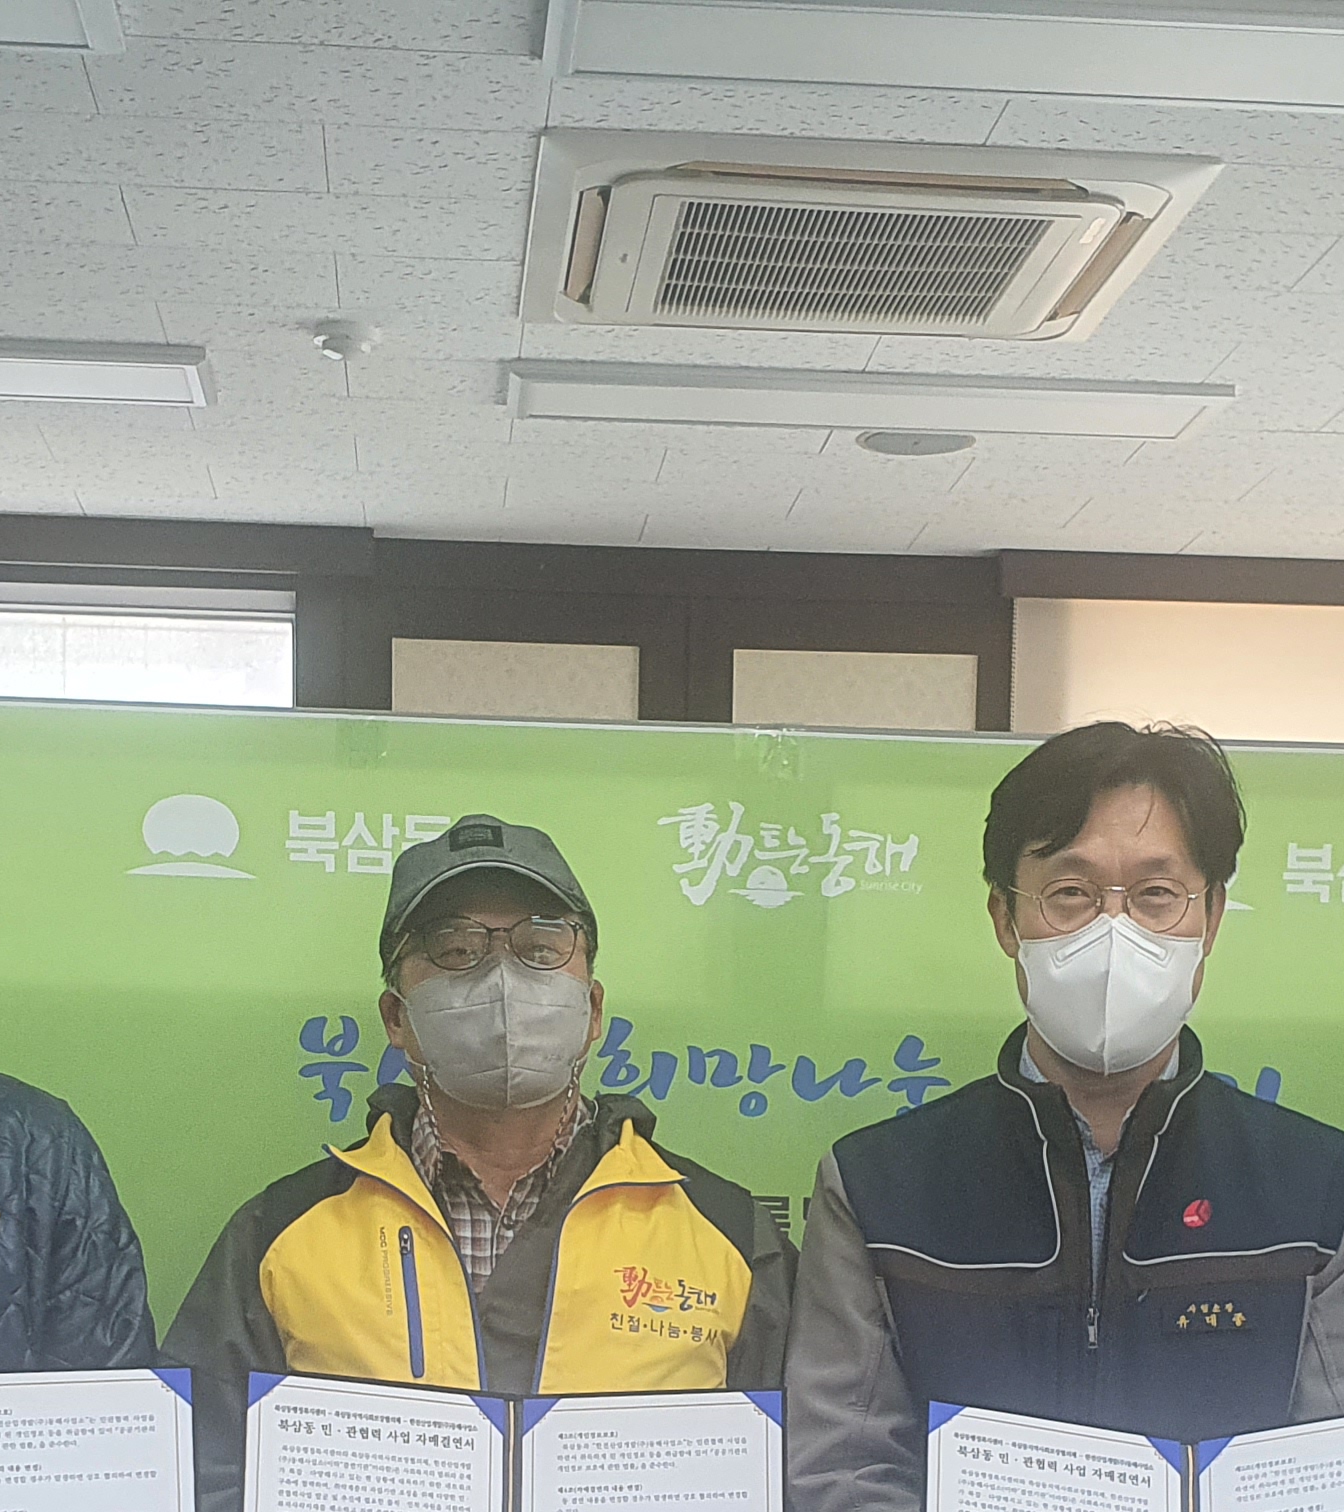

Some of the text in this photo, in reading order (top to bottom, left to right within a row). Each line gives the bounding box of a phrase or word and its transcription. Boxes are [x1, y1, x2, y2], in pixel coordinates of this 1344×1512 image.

[278, 1419, 316, 1434] 북삼동
[386, 1430, 410, 1444] 사업
[957, 1445, 994, 1462] 북삼동
[1063, 1462, 1086, 1477] 사업
